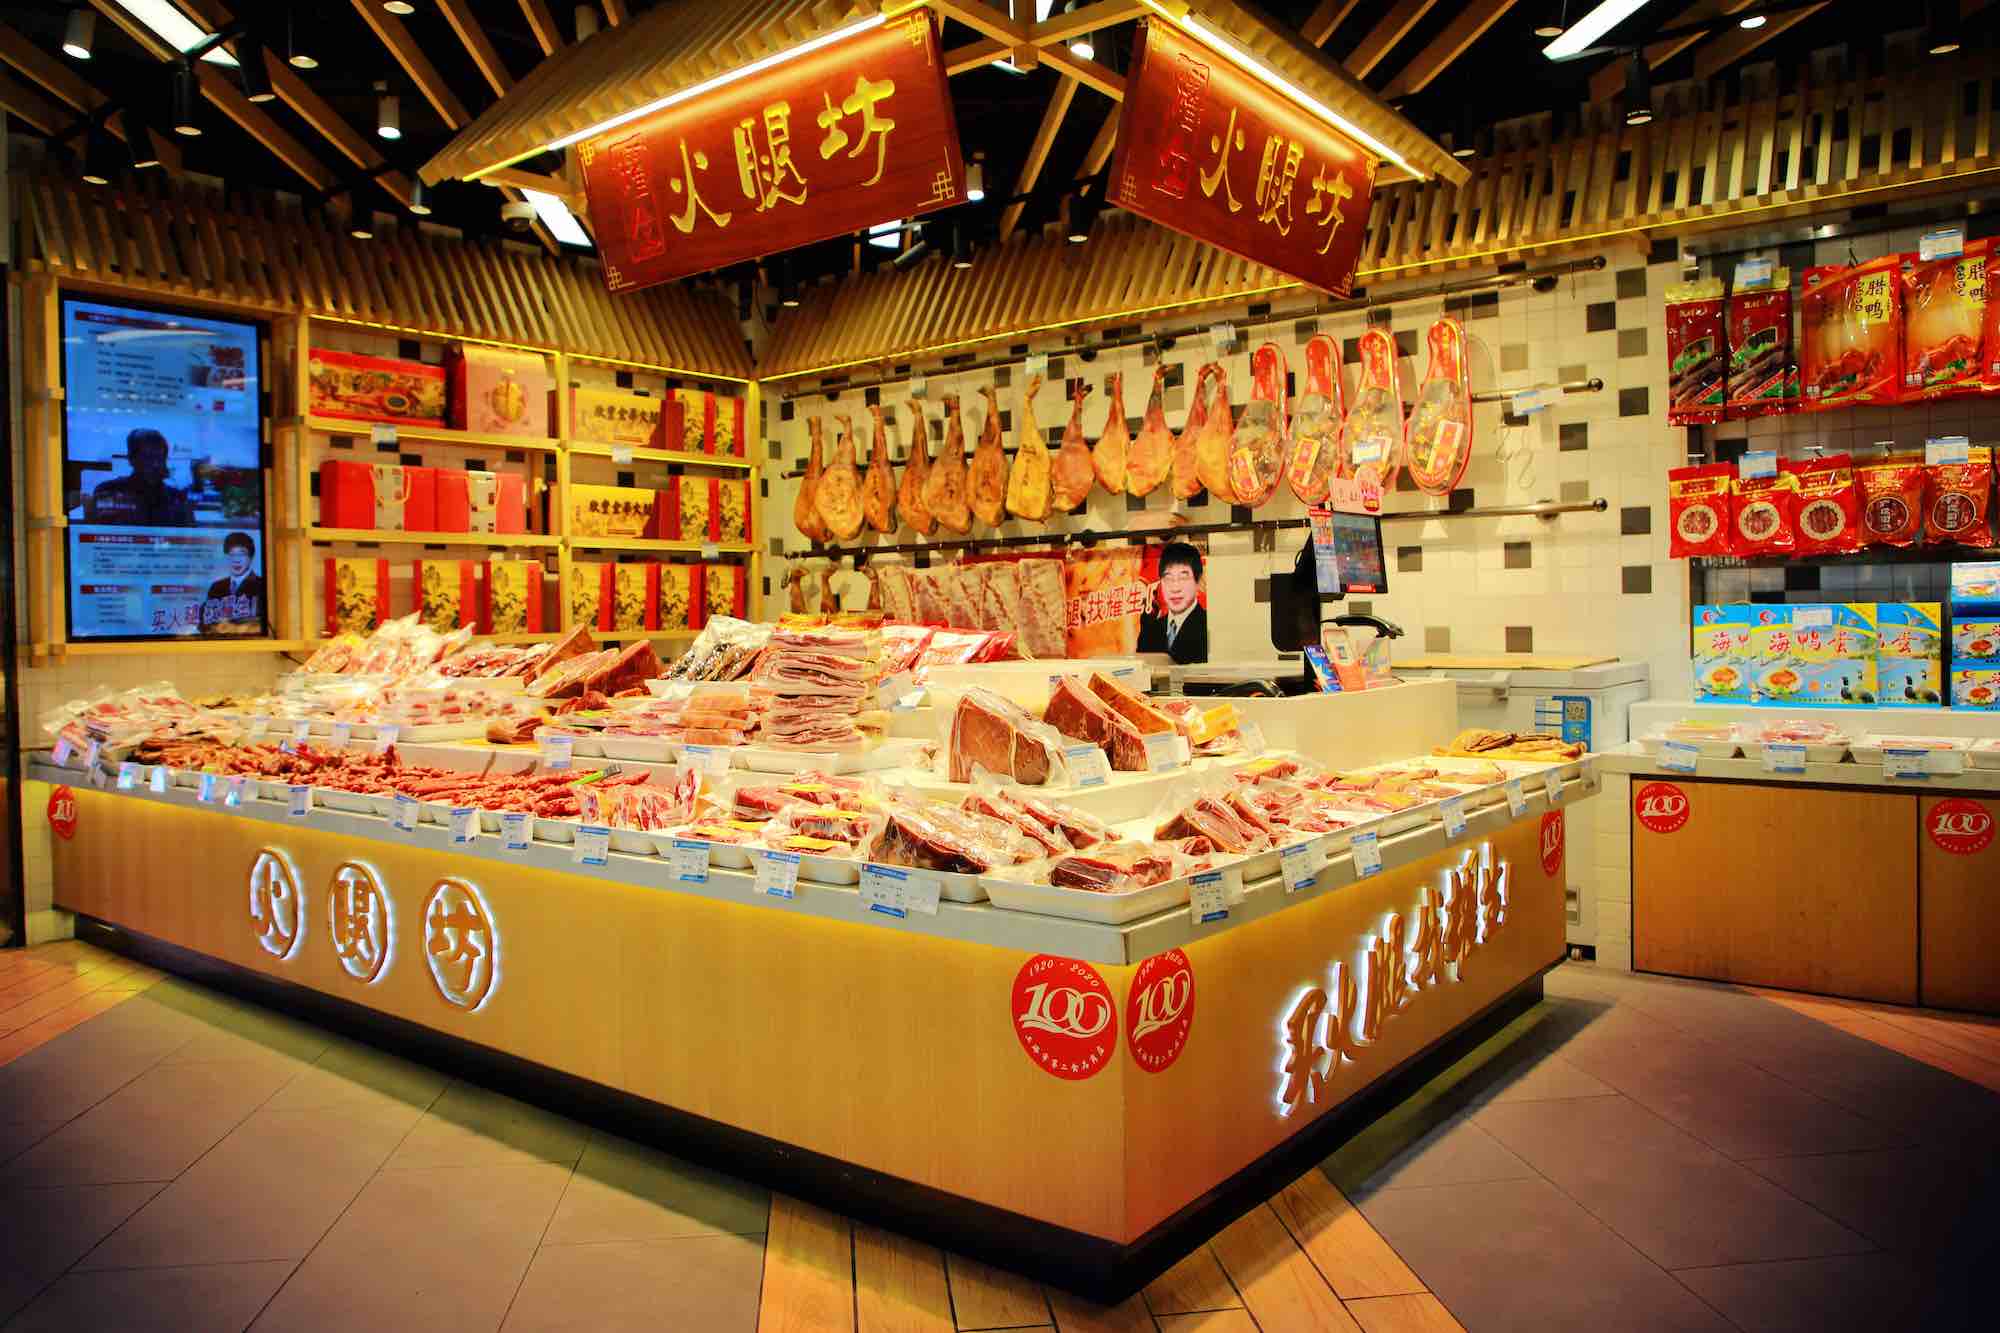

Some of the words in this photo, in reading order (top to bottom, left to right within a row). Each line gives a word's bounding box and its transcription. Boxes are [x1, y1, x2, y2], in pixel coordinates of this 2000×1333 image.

[669, 75, 895, 233] 火腿坊
[1200, 106, 1353, 255] 火腿坊
[1029, 959, 1054, 976] 1920
[1070, 963, 1100, 987] 2020
[1132, 969, 1191, 1043] 100
[1018, 982, 1111, 1039] 100
